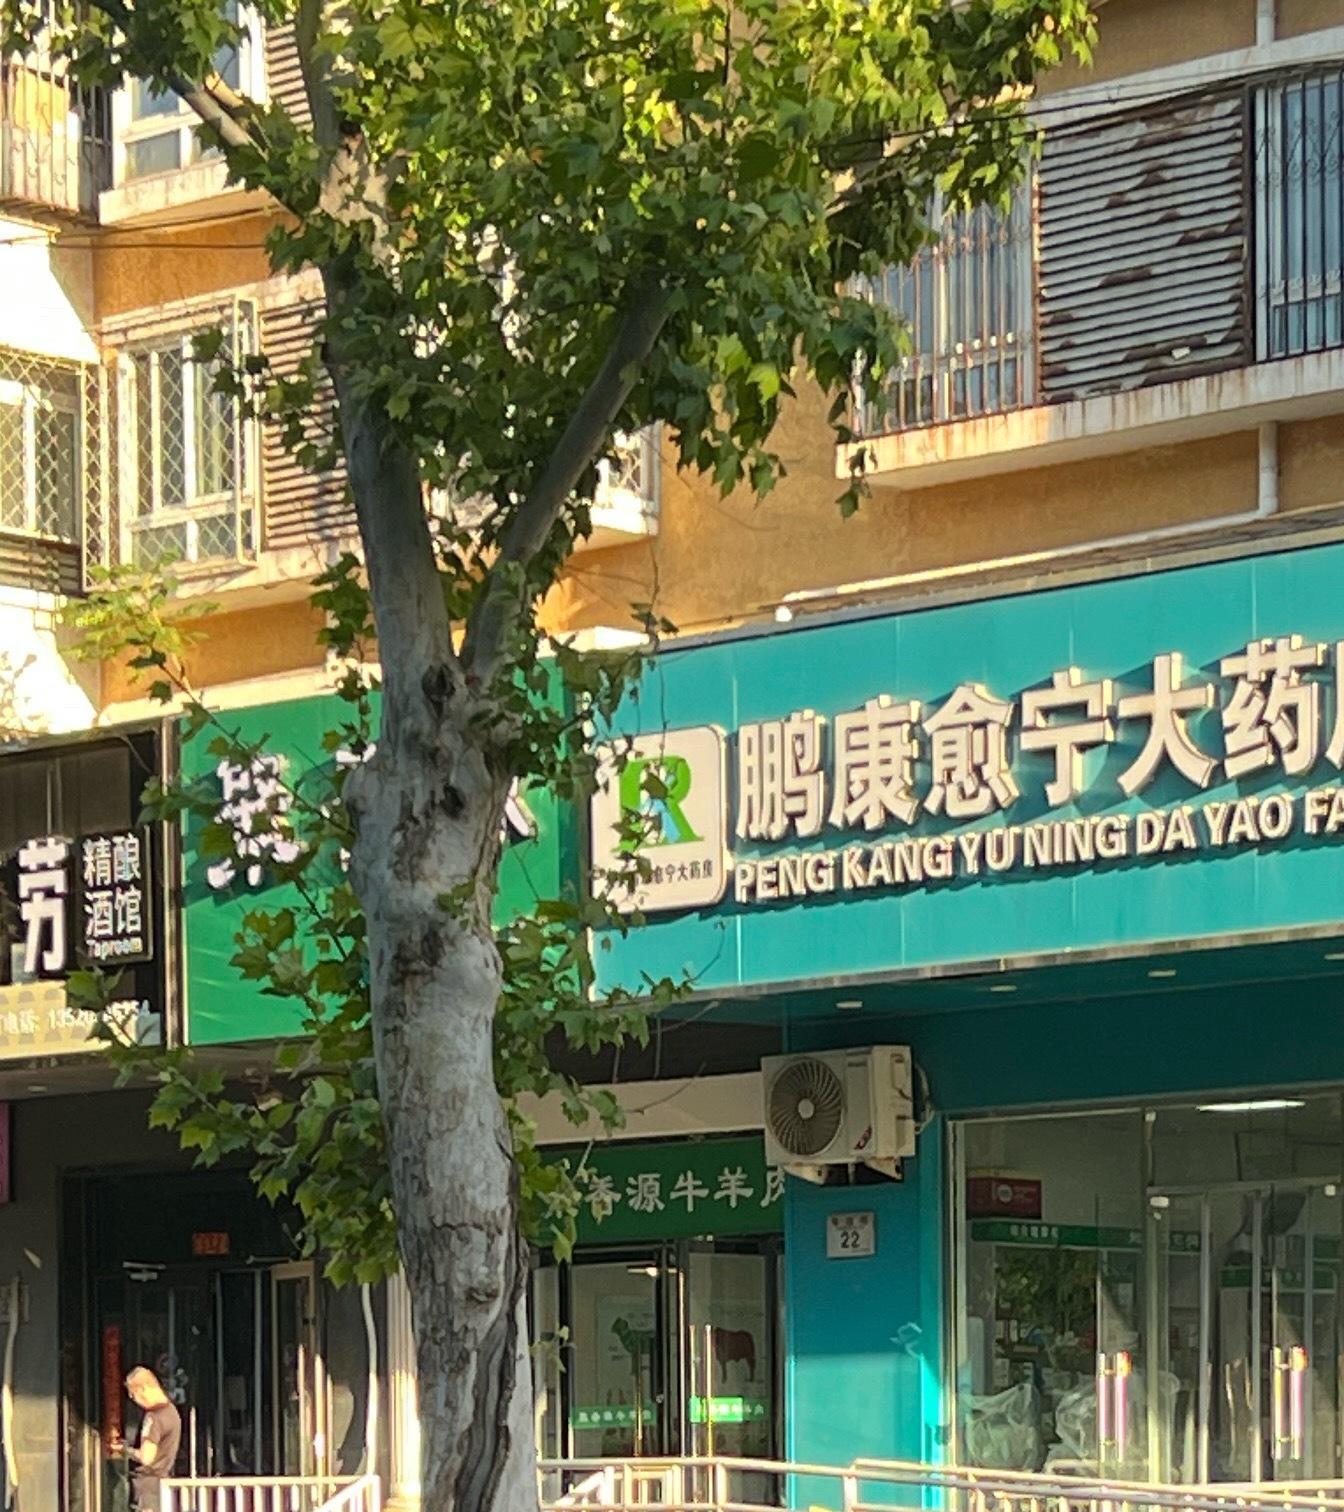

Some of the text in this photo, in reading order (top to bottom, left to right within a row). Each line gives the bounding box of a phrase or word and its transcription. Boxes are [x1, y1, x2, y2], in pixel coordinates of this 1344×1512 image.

[83, 833, 141, 887] 精酿
[734, 851, 837, 903] PENG
[842, 836, 954, 890] KANG
[958, 826, 1022, 875] YU
[1022, 812, 1126, 868] NING
[1135, 804, 1197, 856] DA
[1203, 791, 1294, 846] YAO
[84, 884, 141, 937] 酒馆
[840, 1230, 861, 1249] 22
